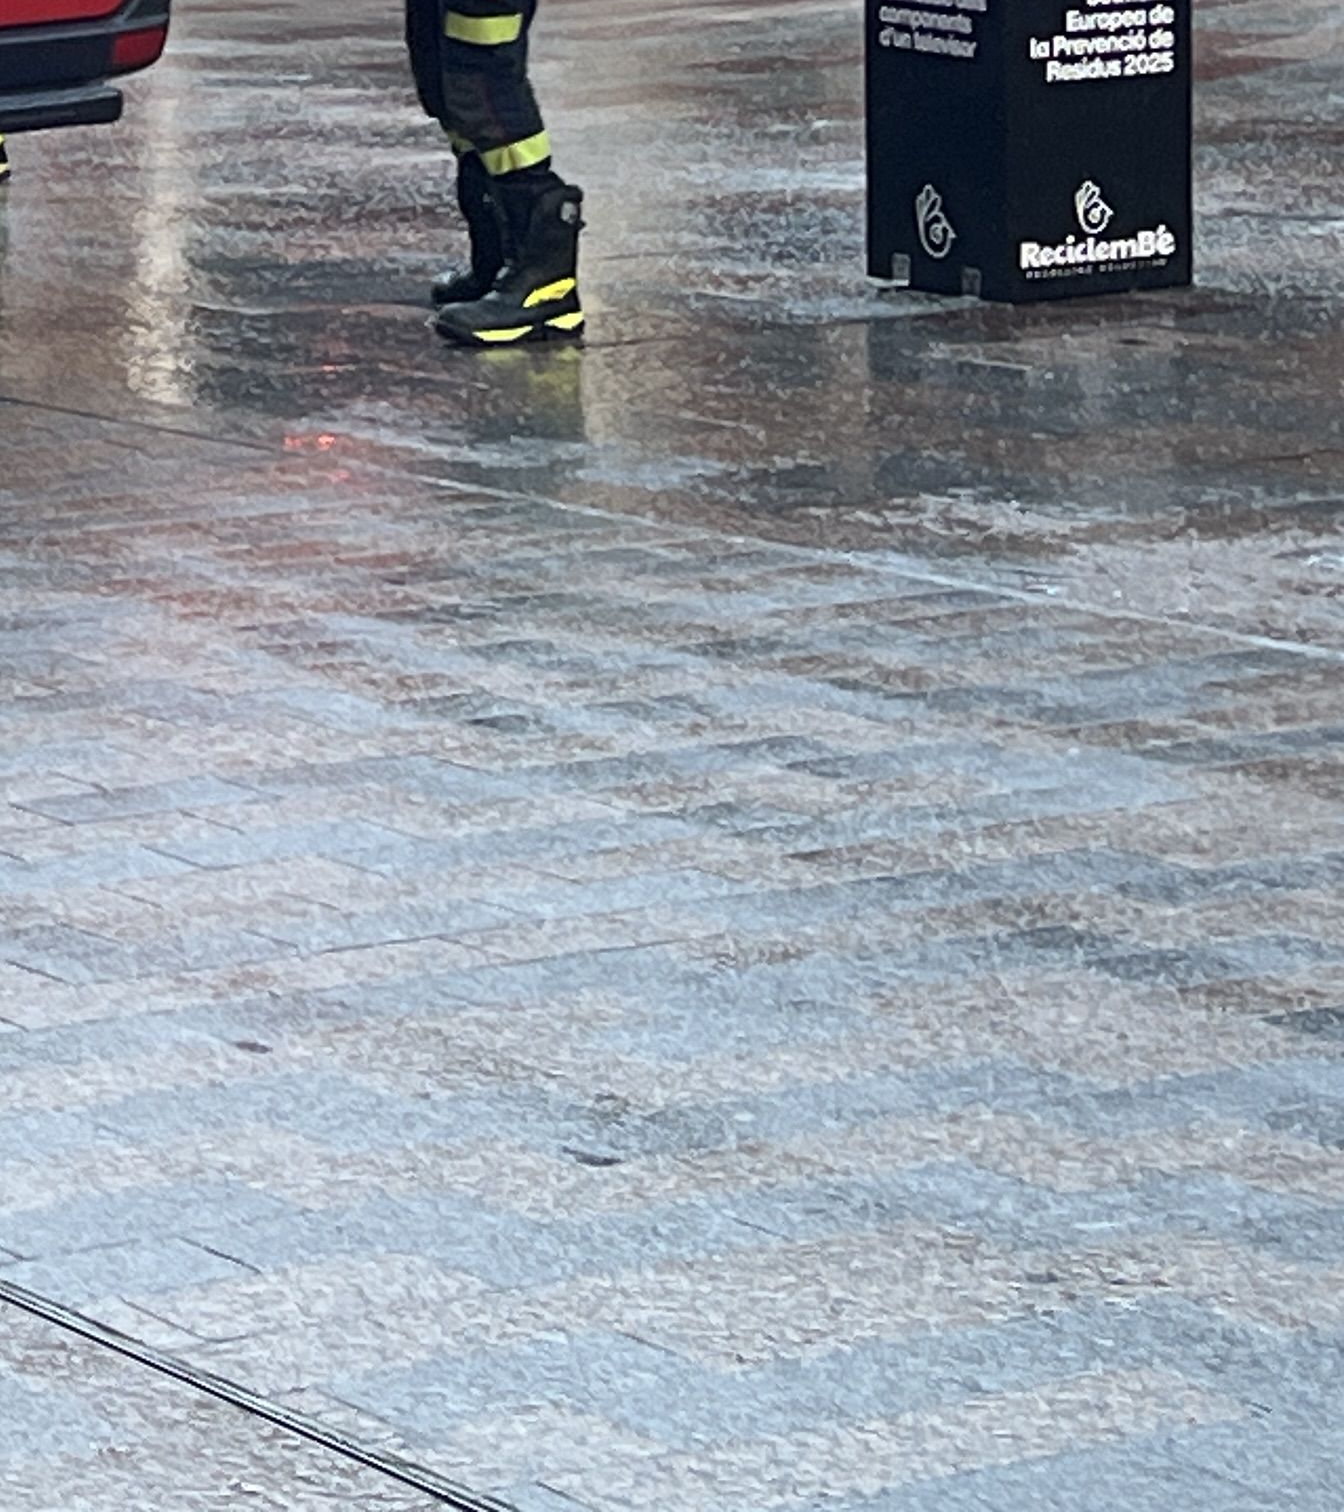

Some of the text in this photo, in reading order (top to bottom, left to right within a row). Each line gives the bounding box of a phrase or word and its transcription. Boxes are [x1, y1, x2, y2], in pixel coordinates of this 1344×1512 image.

[1065, 3, 1175, 33] Europea de
[1029, 27, 1175, 59] la Prevenció de
[1045, 50, 1175, 83] Residus 2025
[1020, 223, 1176, 270] ReciclemBé
